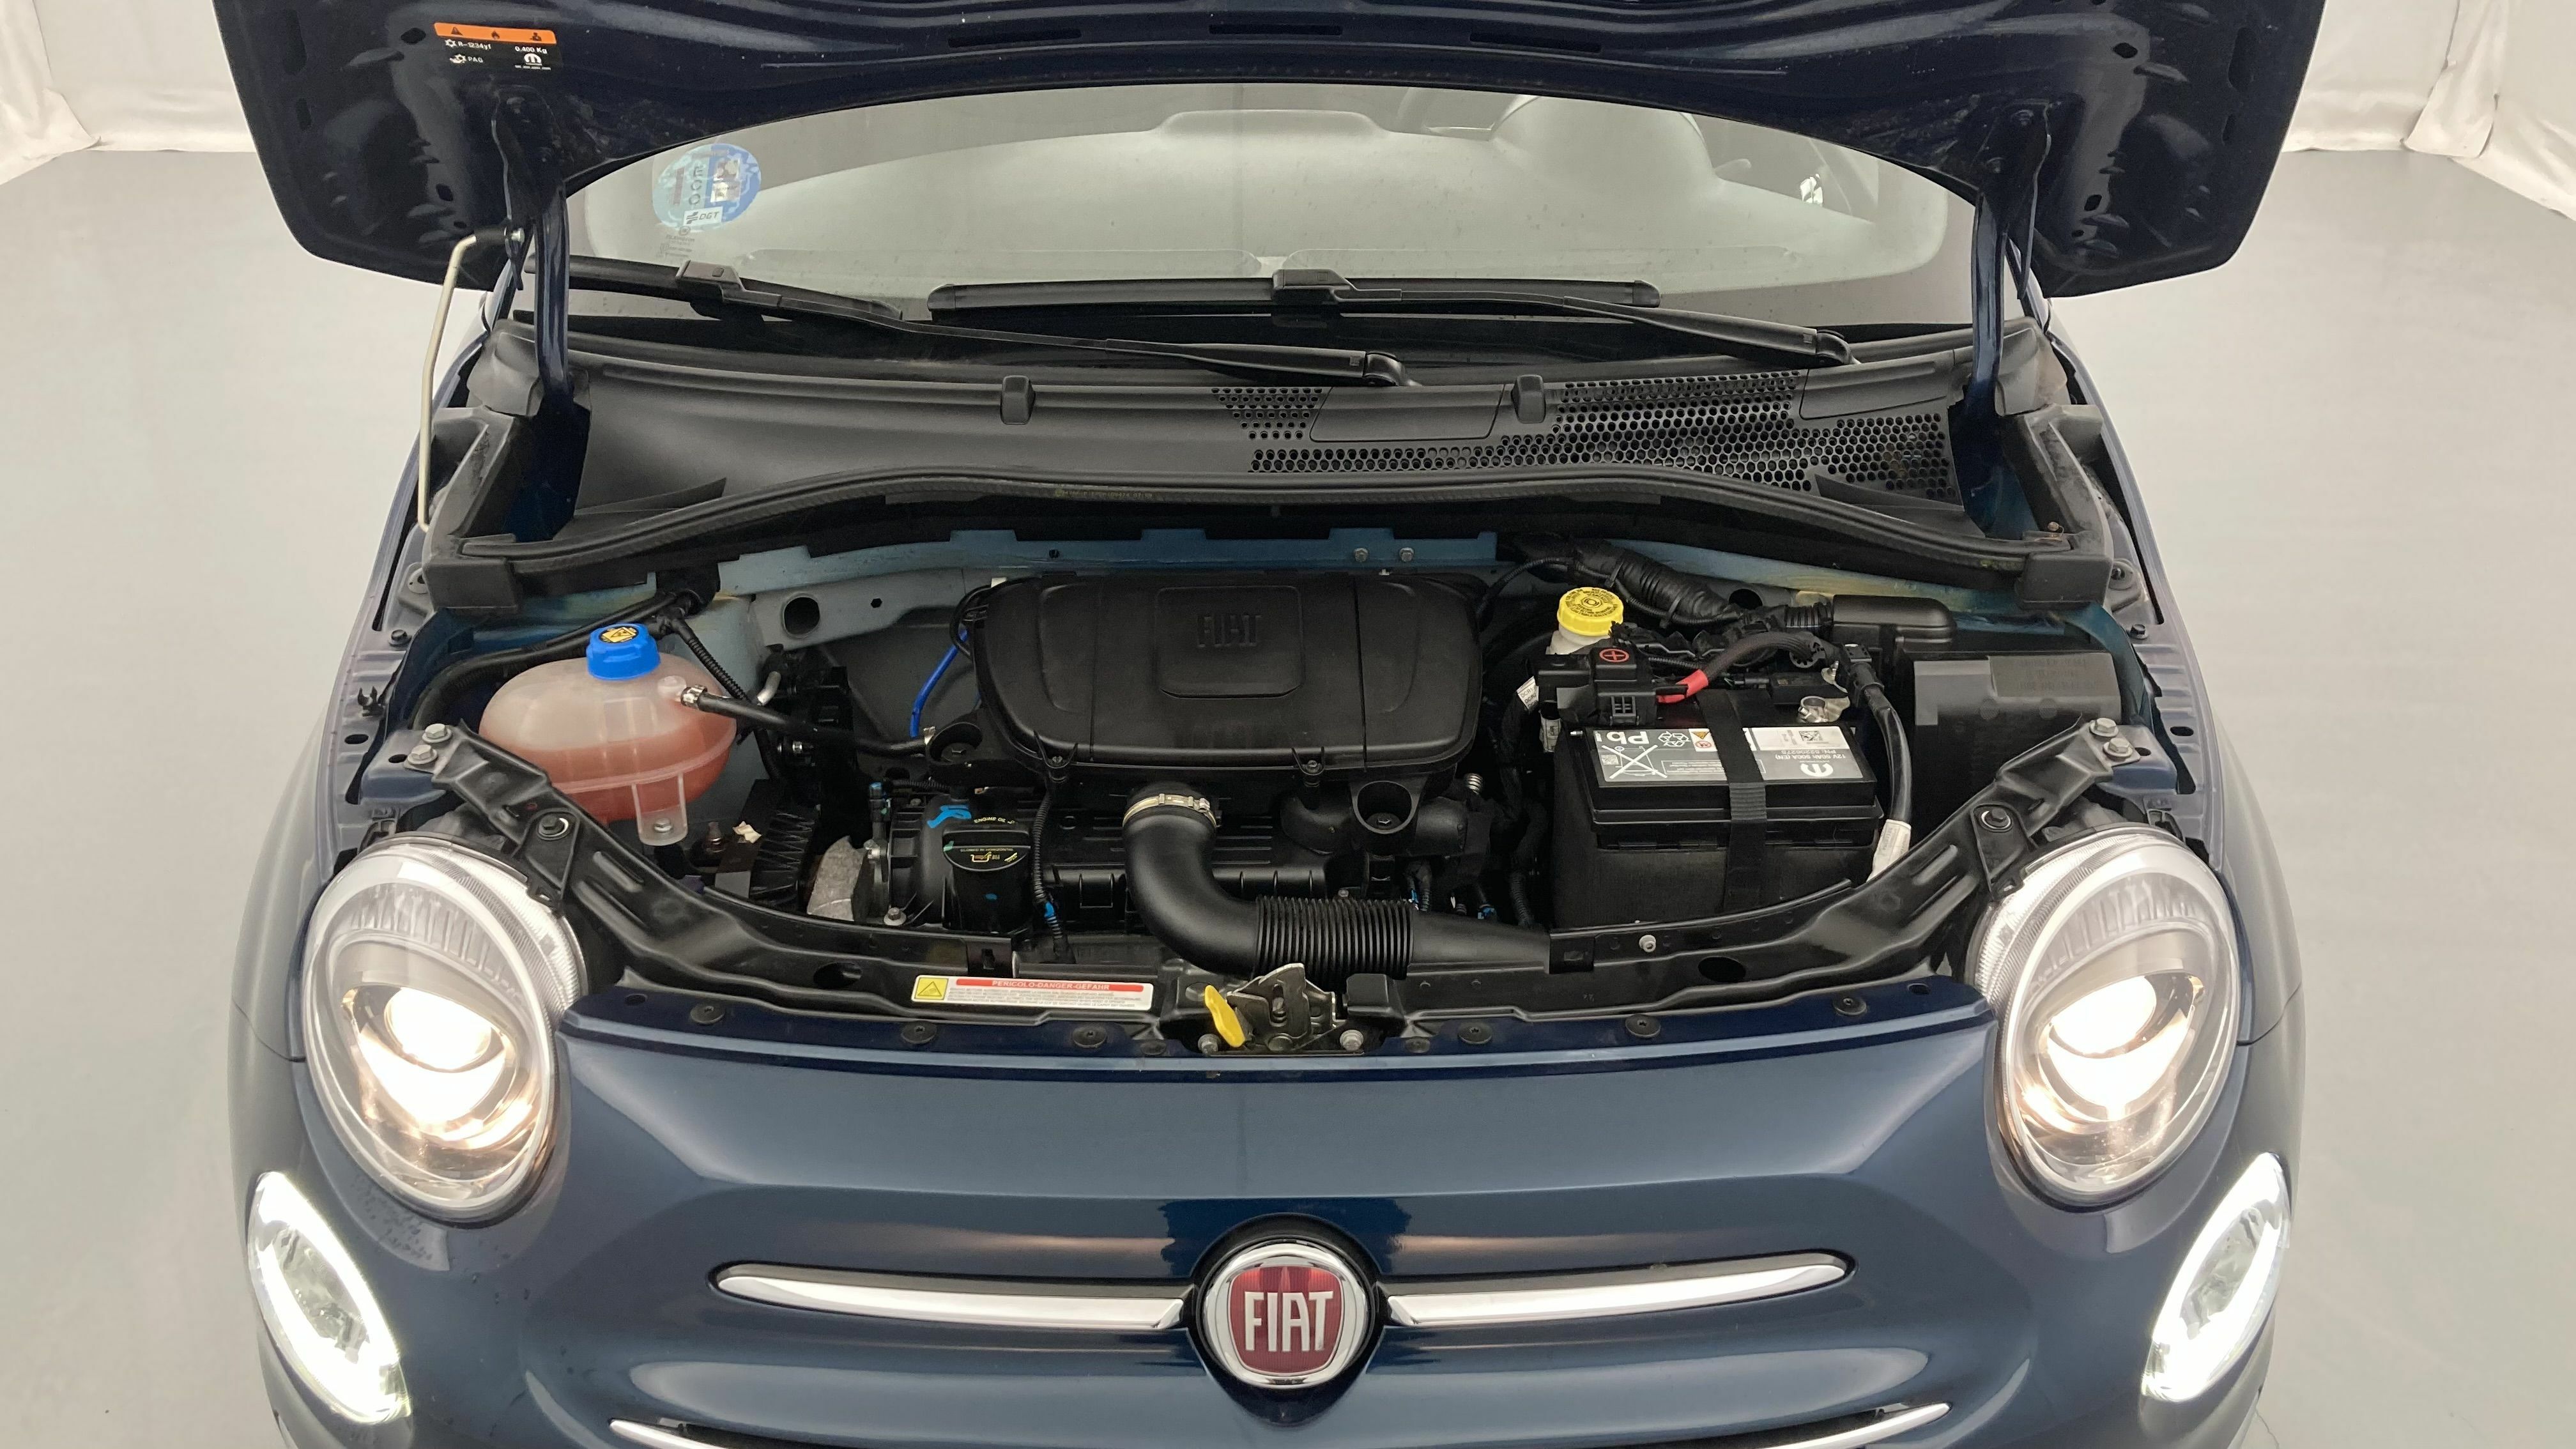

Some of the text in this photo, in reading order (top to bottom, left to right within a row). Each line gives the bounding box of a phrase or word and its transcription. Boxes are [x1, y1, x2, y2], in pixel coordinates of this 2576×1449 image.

[699, 211, 720, 220] DGT
[1197, 615, 1262, 648] FIAT
[1606, 731, 1650, 745] Pb
[1245, 1291, 1333, 1352] FIAT
